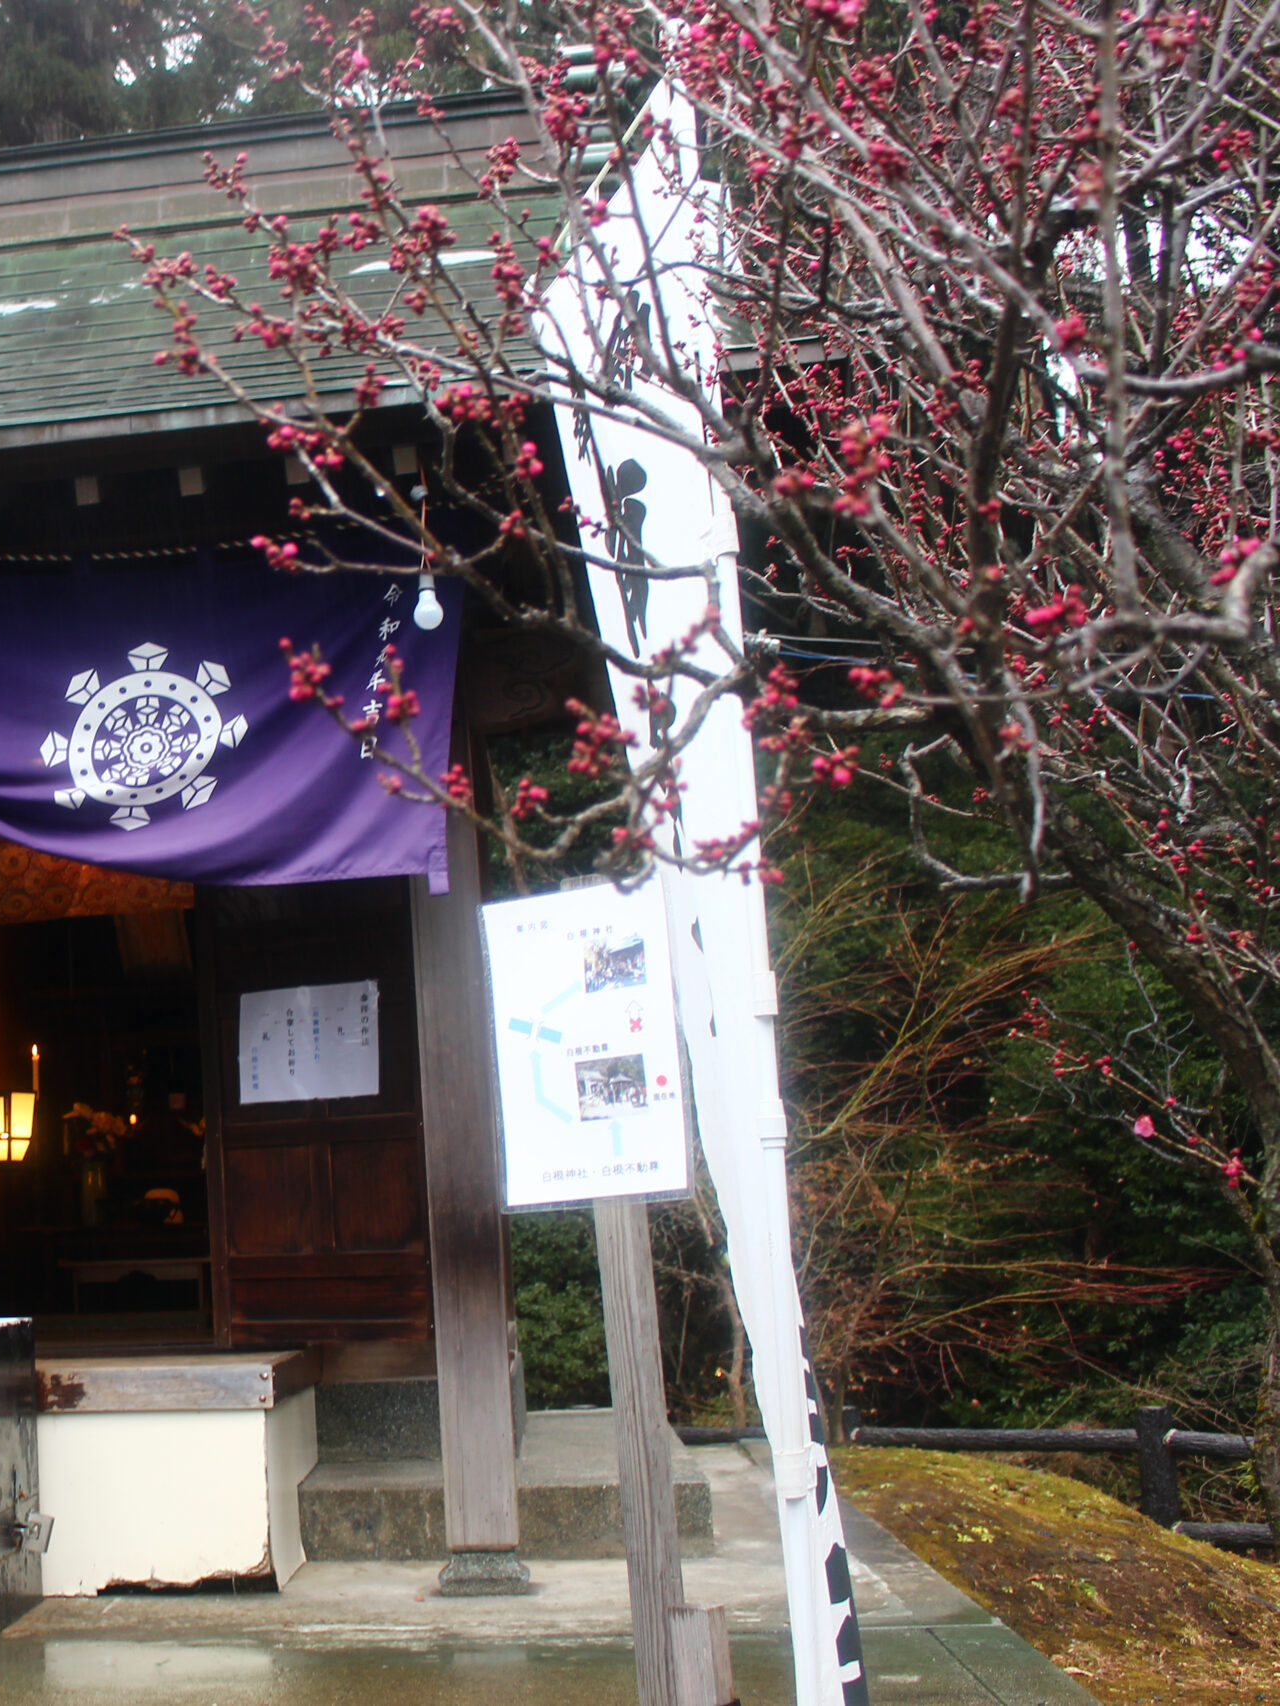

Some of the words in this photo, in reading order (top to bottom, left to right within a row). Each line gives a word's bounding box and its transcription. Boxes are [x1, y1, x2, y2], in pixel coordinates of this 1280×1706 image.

[360, 583, 404, 760] 令和元年吉日
[566, 924, 613, 941] 白根神社
